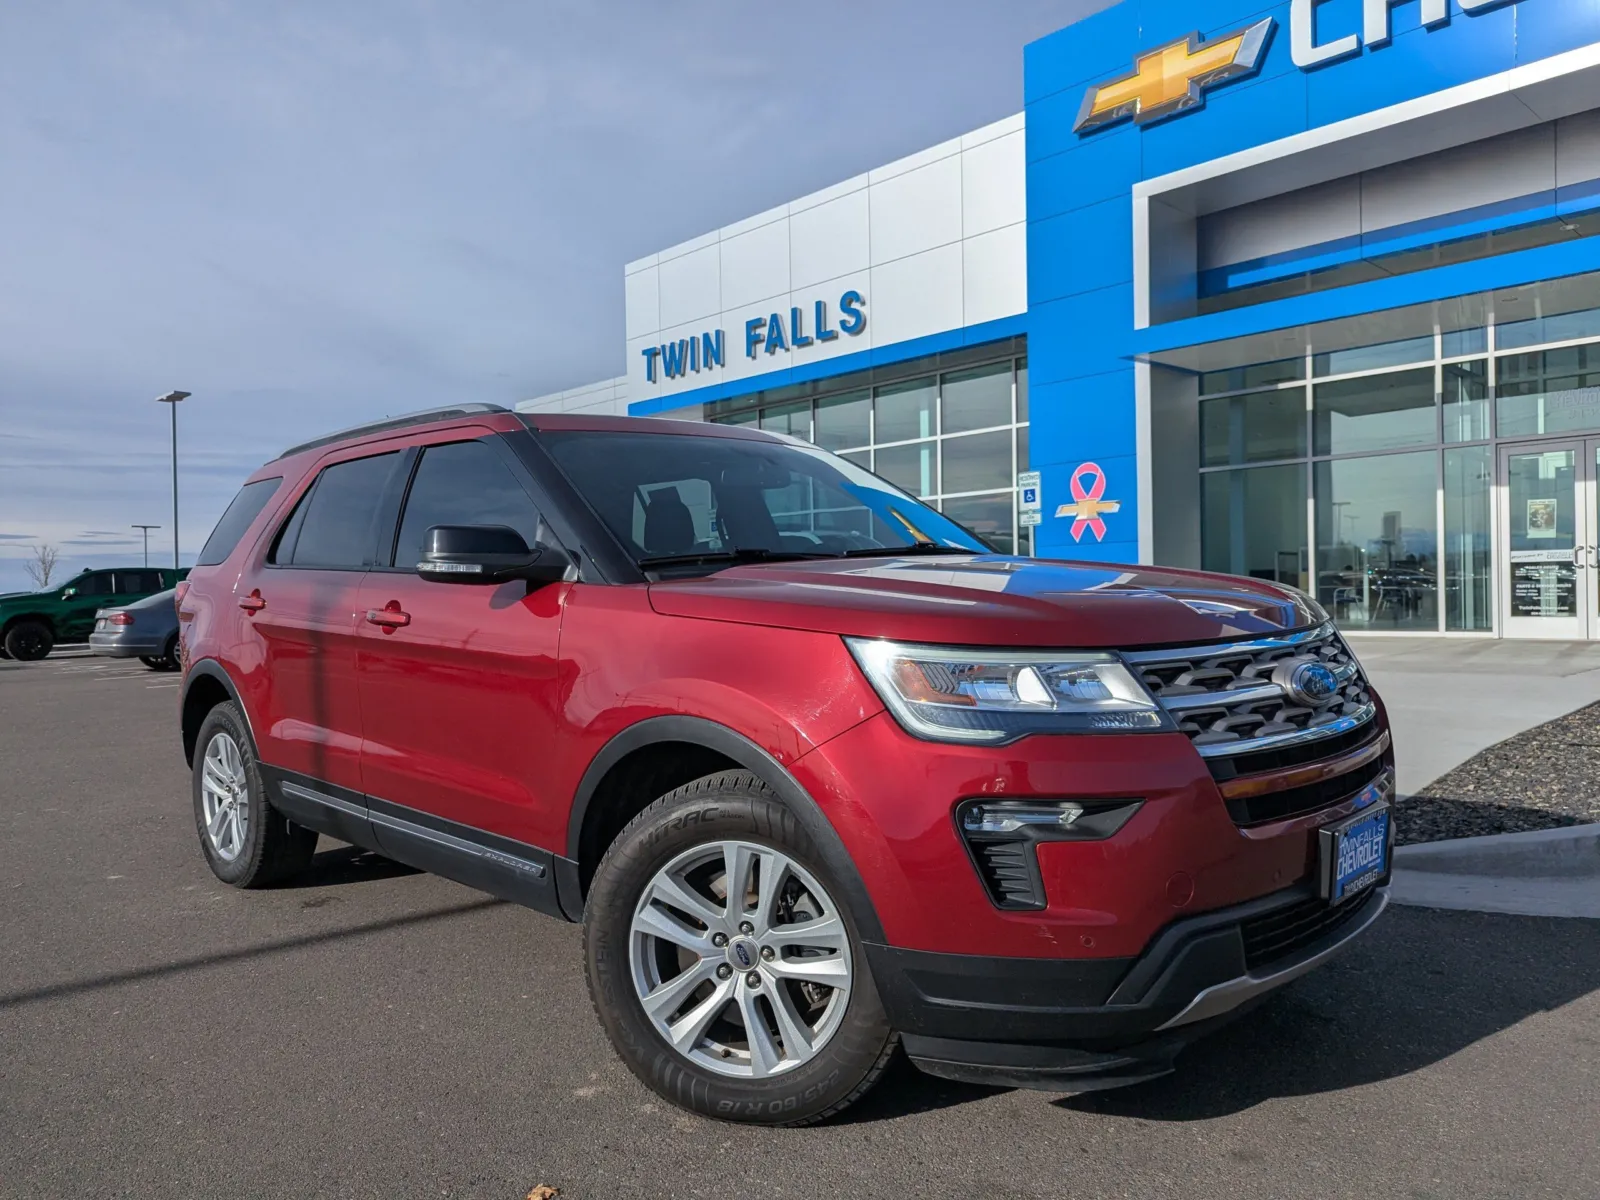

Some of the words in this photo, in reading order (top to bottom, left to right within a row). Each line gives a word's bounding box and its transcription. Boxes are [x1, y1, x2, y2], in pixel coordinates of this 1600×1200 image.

[641, 329, 725, 383] TWIN
[745, 290, 867, 359] FALLS
[1336, 835, 1384, 881] CHEVROLET
[1357, 823, 1385, 848] FALLS
